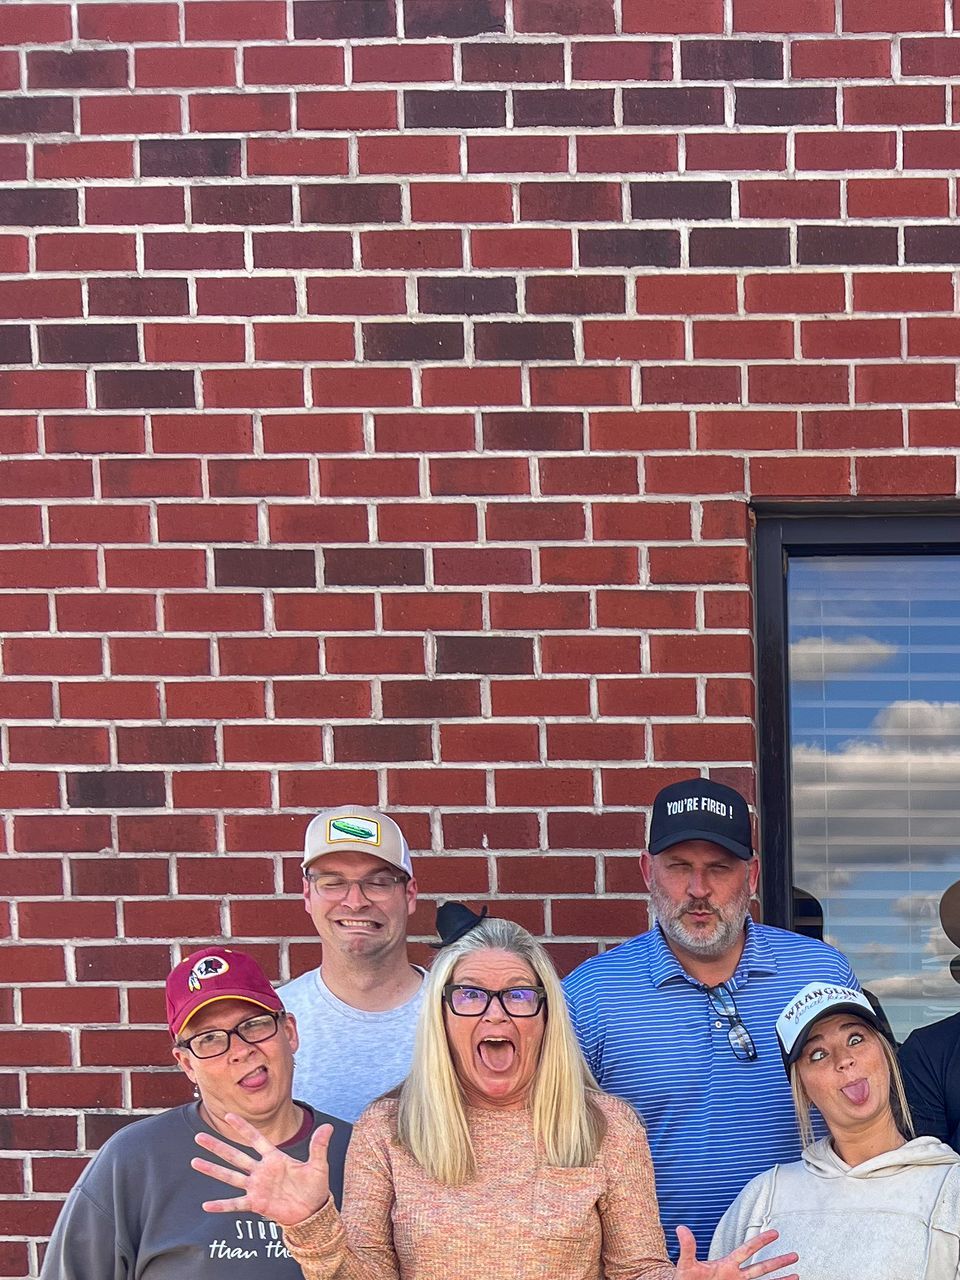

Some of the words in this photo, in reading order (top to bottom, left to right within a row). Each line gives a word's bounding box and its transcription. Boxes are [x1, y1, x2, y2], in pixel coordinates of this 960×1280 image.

[666, 796, 699, 816] YOU'RE
[701, 796, 727, 817] FIRED
[209, 1239, 259, 1259] than
